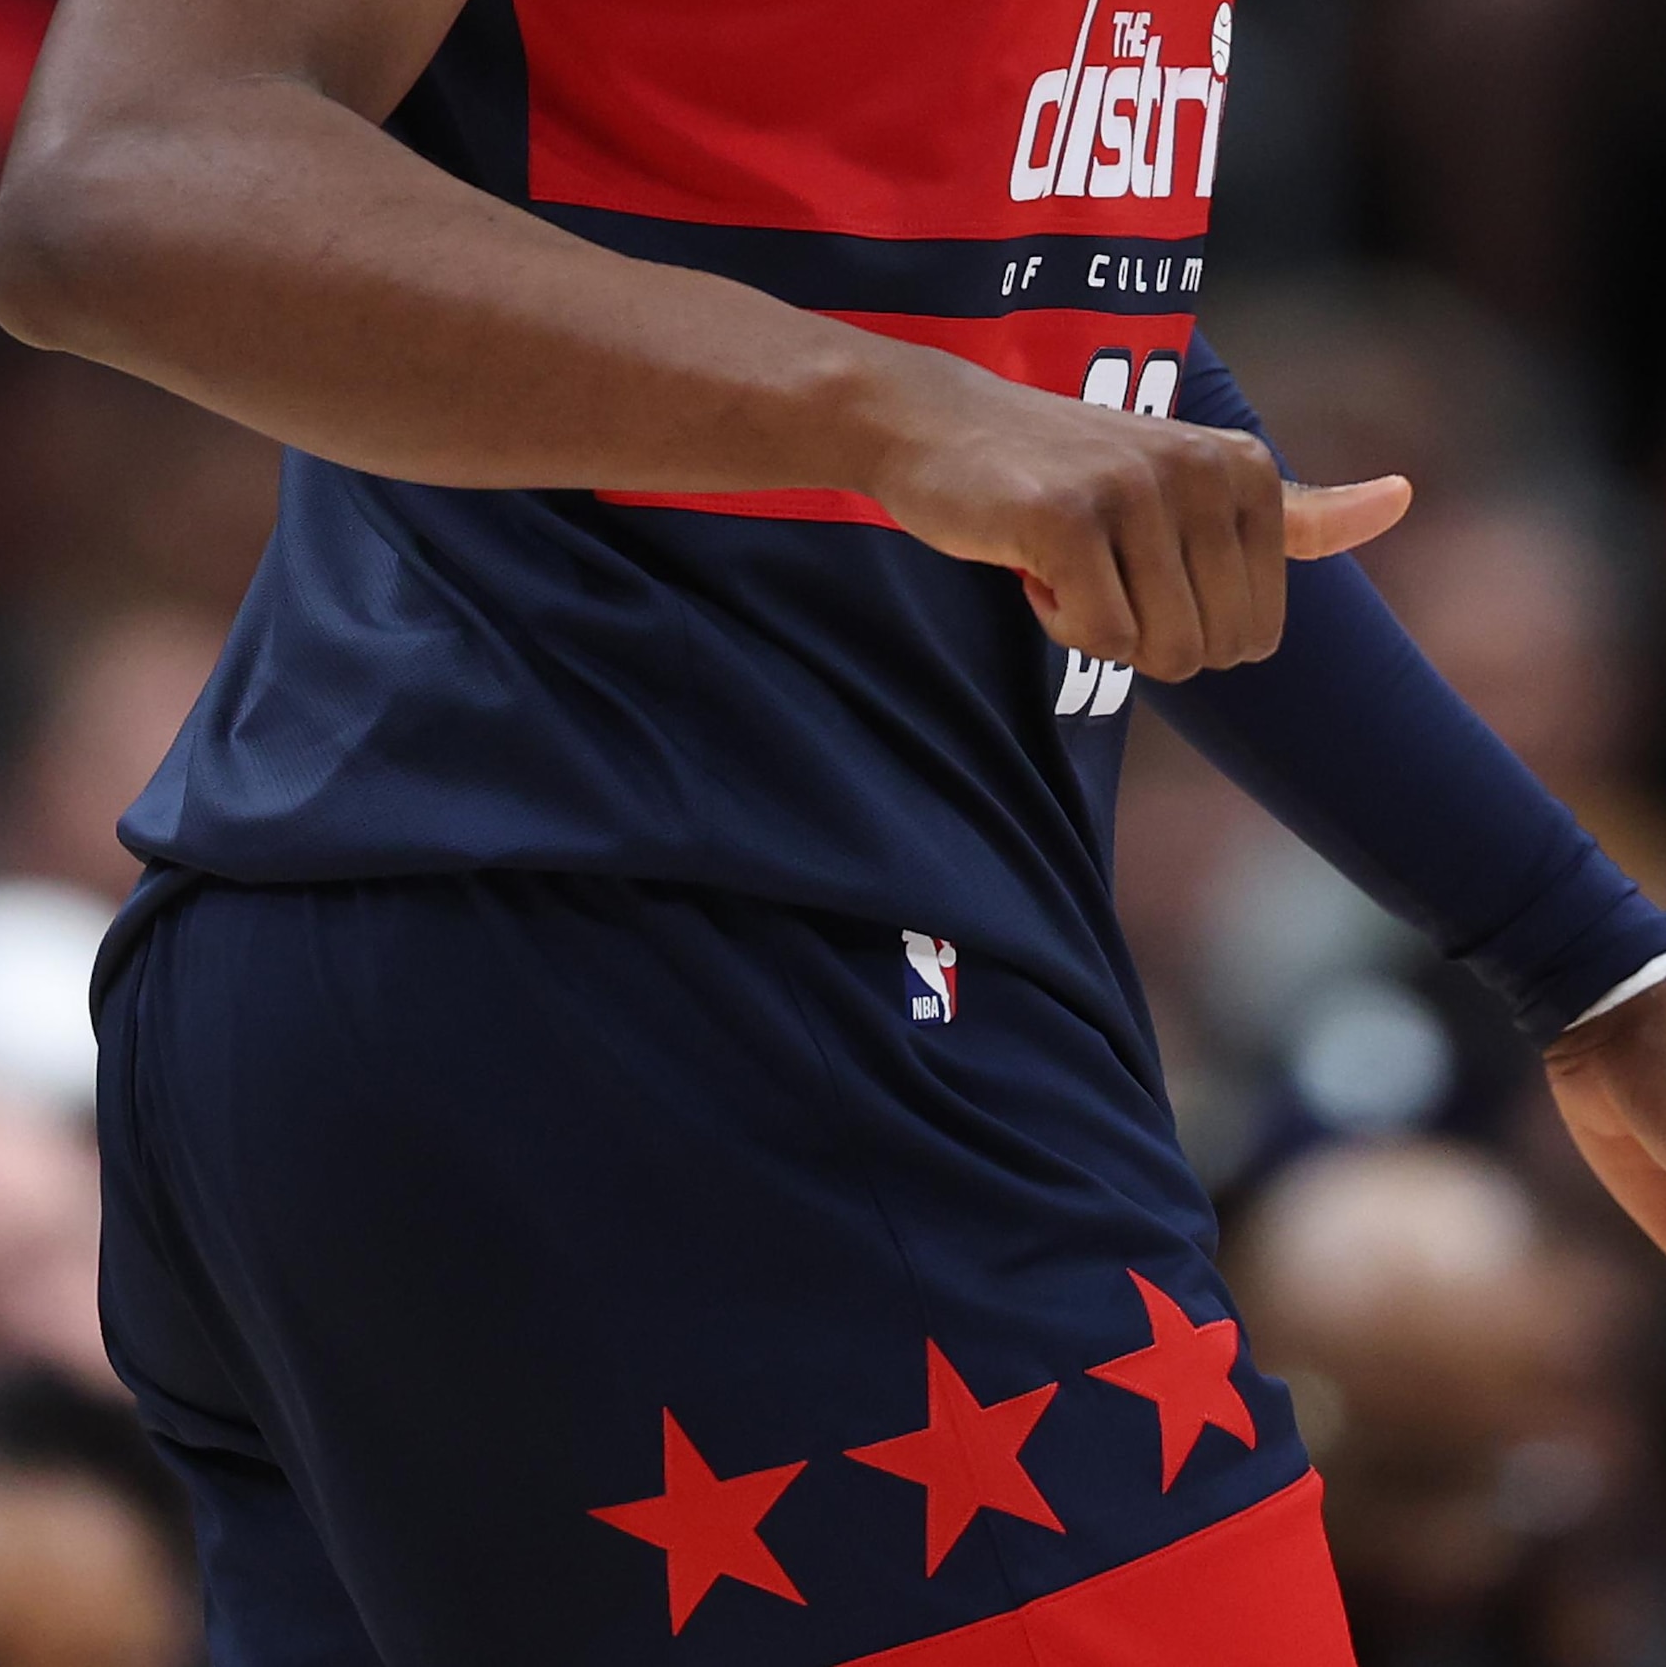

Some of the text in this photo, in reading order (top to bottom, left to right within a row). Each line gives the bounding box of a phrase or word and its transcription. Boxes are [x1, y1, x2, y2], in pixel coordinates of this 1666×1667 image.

[1113, 11, 1151, 57] THE
[1001, 256, 1042, 296] OF
[912, 995, 940, 1020] NBA
